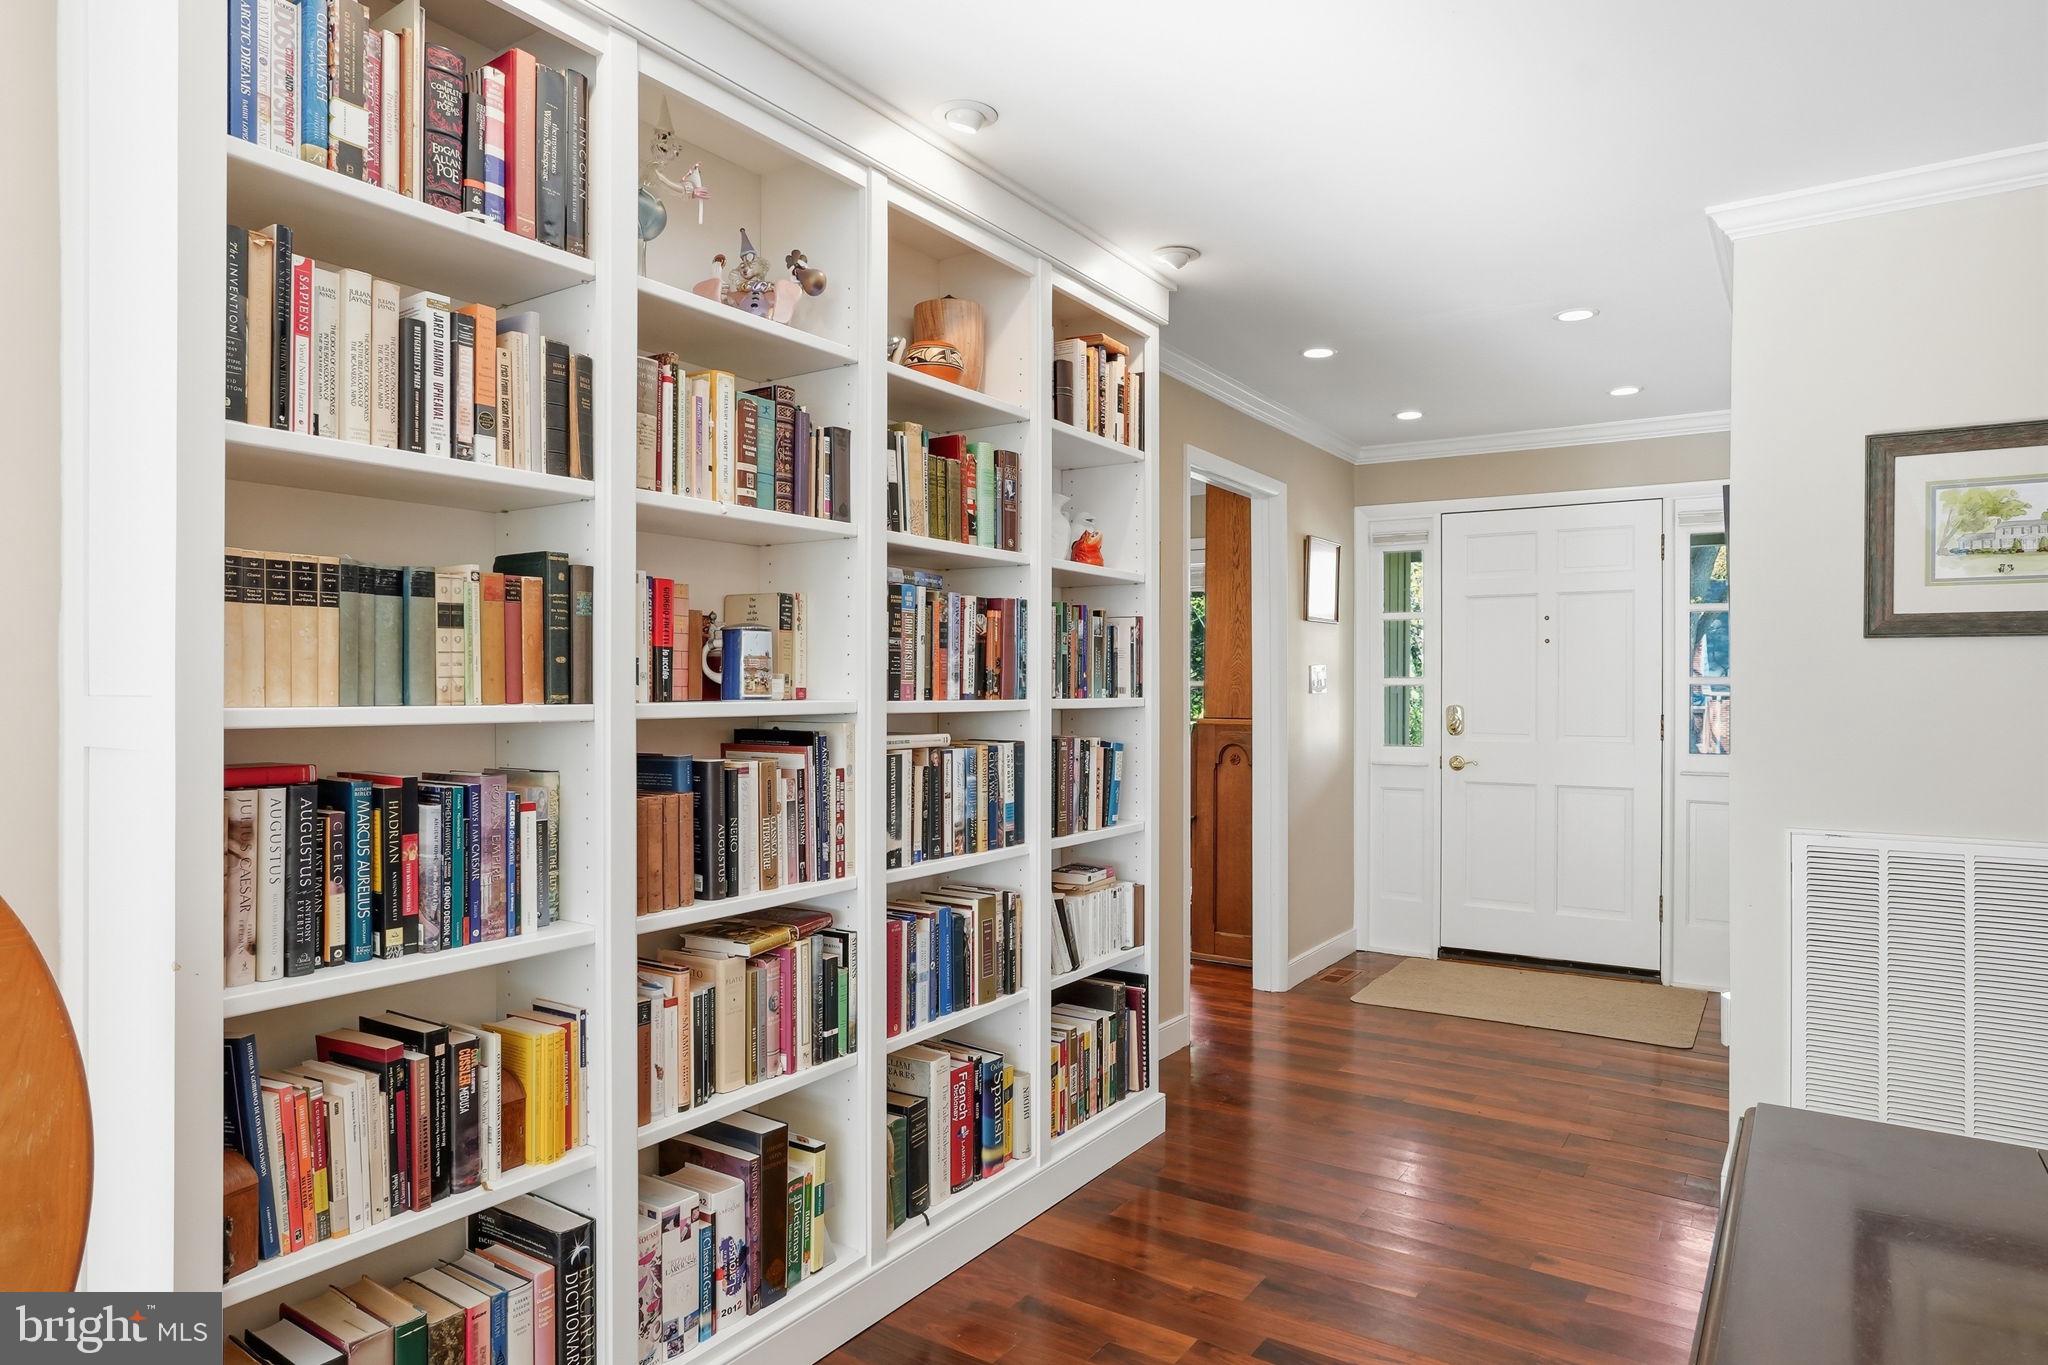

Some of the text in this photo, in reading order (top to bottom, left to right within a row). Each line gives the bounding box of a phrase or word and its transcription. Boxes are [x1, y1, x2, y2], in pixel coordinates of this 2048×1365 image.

[240, 0, 250, 46] ARCTIC
[240, 46, 251, 96] DREAMS
[316, 13, 328, 102] GILGAMESH
[285, 47, 295, 146] CRIME AND PUNISHMENT
[430, 80, 463, 99] COMPLETE
[436, 101, 460, 117] POEMS
[438, 90, 460, 102] TALES
[432, 143, 462, 160] EDGAR
[432, 154, 462, 172] ALLAN
[436, 164, 460, 183] POE
[228, 262, 238, 334] INVENTION
[298, 275, 310, 332] SAPIENS
[298, 342, 308, 413] Yuval Noah Harari
[434, 312, 444, 420] JARED DIAMOND UPHEAVAL
[501, 364, 509, 376] Erich
[662, 587, 670, 616] GIORGIO
[662, 657, 670, 680] uccido
[904, 614, 914, 679] JOHN MARSHALL
[238, 799, 252, 913] JULIUS CAESAR
[269, 798, 282, 886] AUGUSTUS
[300, 797, 312, 887] AUGUSTUS
[334, 822, 342, 885] CICERO
[389, 800, 400, 863] HADRIAN
[472, 829, 478, 842] AM
[492, 784, 500, 882] ROMAN EMPIRE
[730, 816, 738, 852] NERO
[762, 818, 771, 870] LITERATURE
[770, 816, 778, 858] CLASSICAL
[315, 820, 323, 913] THE LAST PAGAN
[357, 800, 370, 918] MARCUS AURELIUS
[472, 844, 480, 880] CAESAR
[549, 855, 557, 868] THE
[549, 870, 557, 890] CELTS
[296, 900, 304, 944] EVERITT
[443, 910, 451, 935] DESIGN
[458, 1048, 470, 1114] CUSSLER MEDUSA
[952, 1084, 960, 1122] Dictionary
[958, 1072, 968, 1120] French
[990, 1070, 1003, 1144] Spanish
[941, 1126, 950, 1182] Shakespeare
[790, 1200, 803, 1264] Dictionary
[702, 1238, 711, 1313] Classical Greek
[728, 1239, 737, 1286] Larousse
[721, 1300, 743, 1318] 2012
